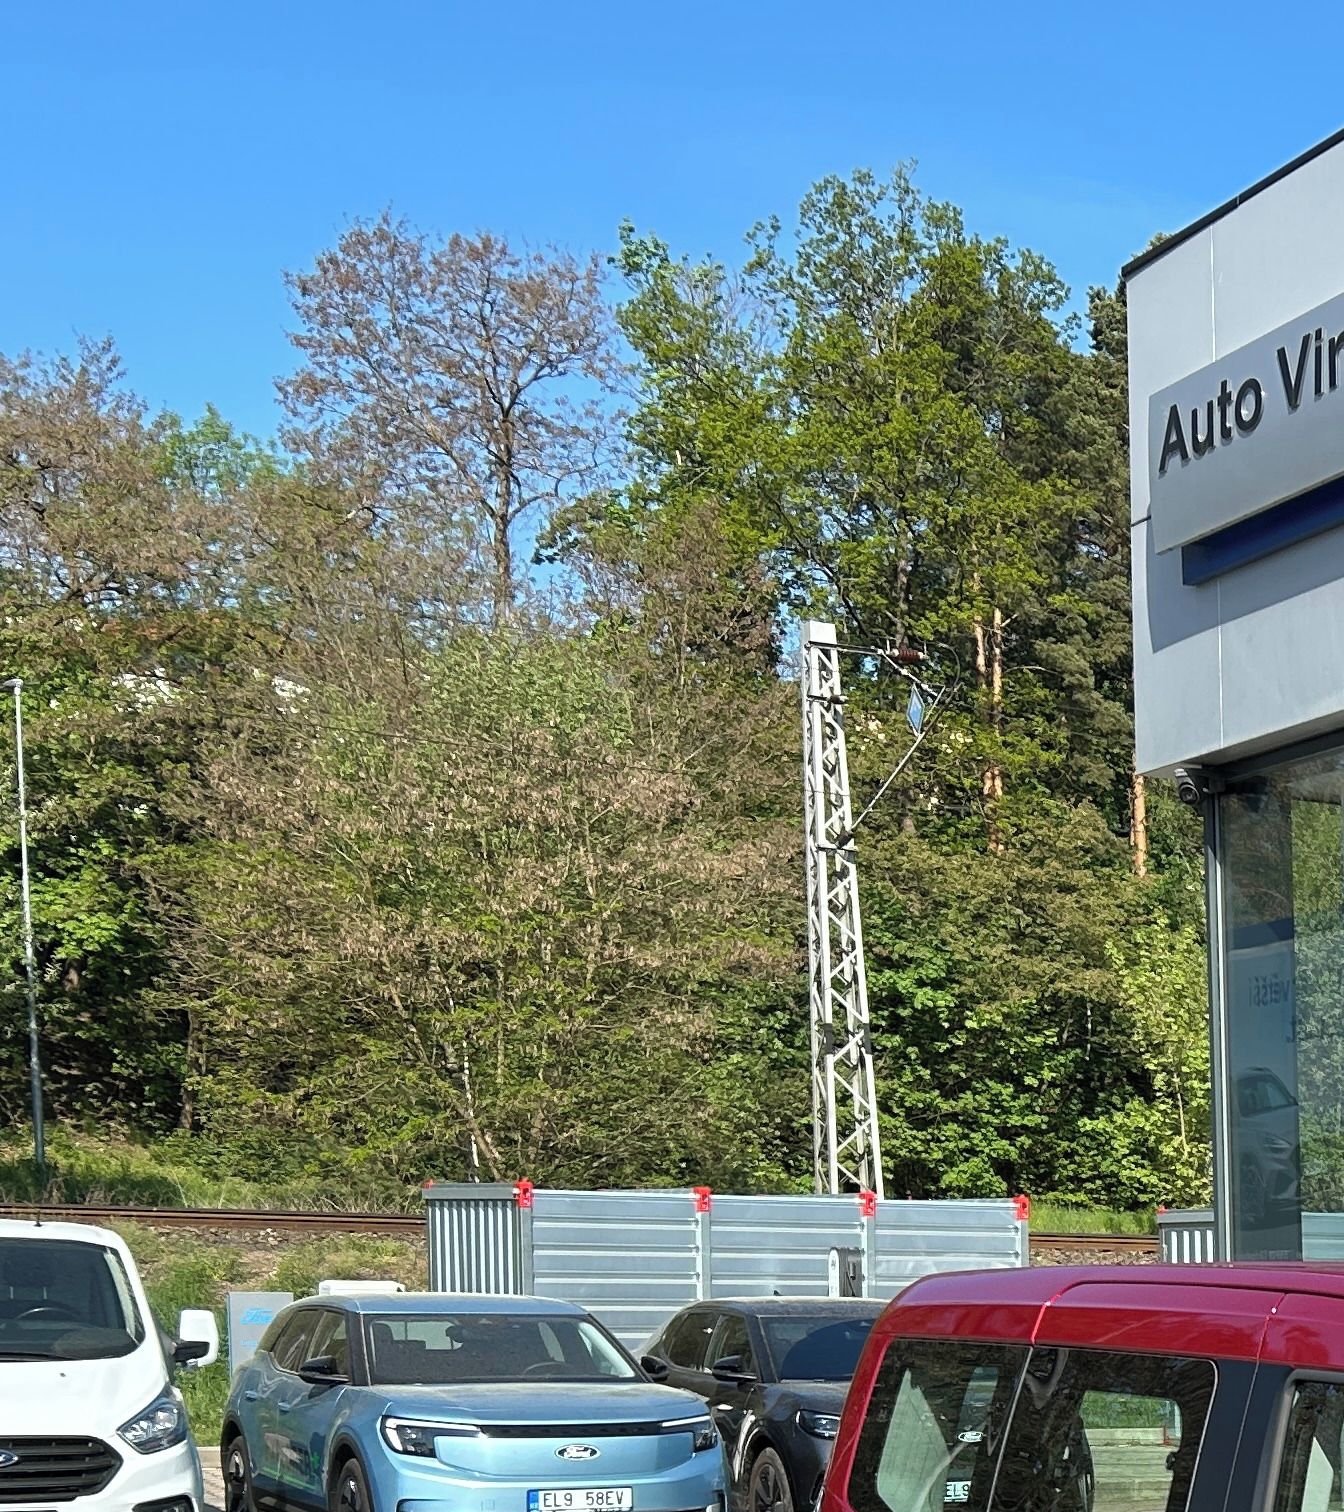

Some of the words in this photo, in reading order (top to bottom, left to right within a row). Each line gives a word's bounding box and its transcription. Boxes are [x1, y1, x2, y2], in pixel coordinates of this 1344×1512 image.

[1158, 377, 1266, 477] Auto
[543, 1493, 573, 1507] EL9
[586, 1490, 624, 1506] 58EV
